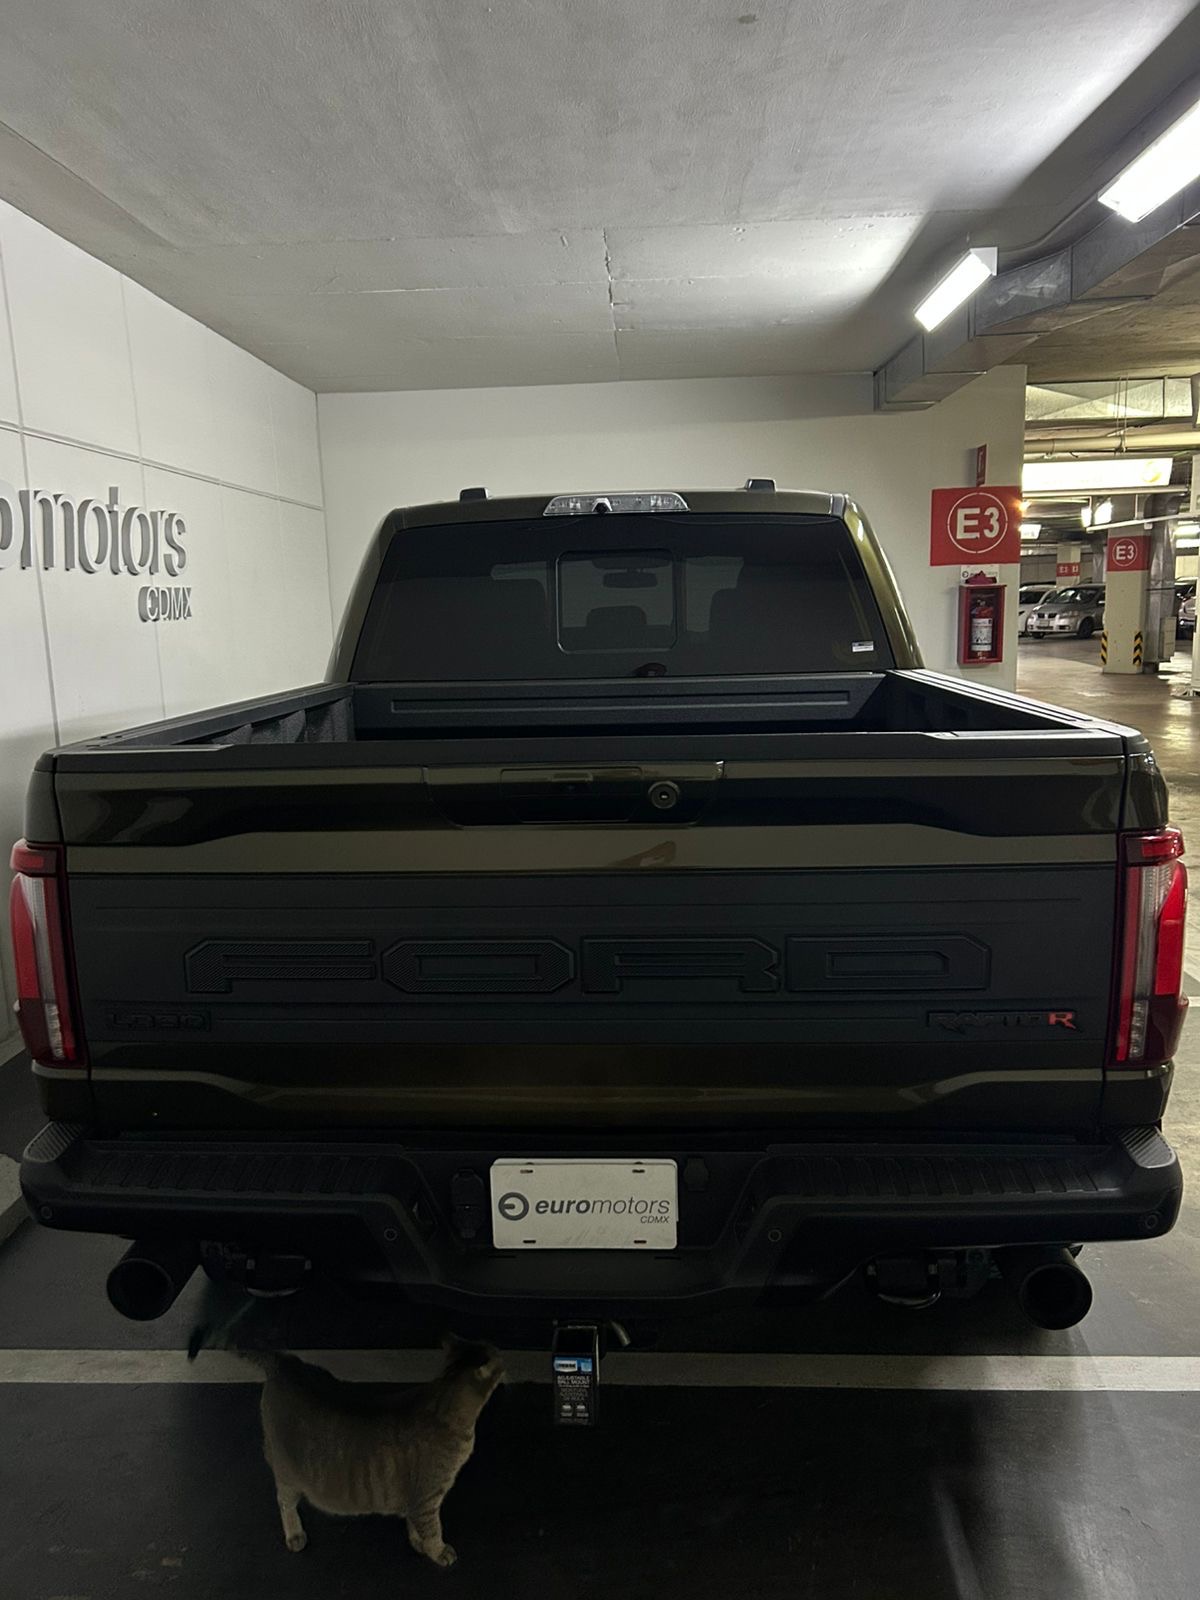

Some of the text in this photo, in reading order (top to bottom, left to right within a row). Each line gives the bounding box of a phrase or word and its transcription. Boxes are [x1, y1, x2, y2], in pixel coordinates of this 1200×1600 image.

[956, 506, 1000, 540] E3
[1115, 545, 1135, 560] E3
[138, 586, 193, 622] CDMX
[184, 934, 991, 994] FORD
[535, 1196, 671, 1215] euromotors
[640, 1215, 670, 1224] CDMX
